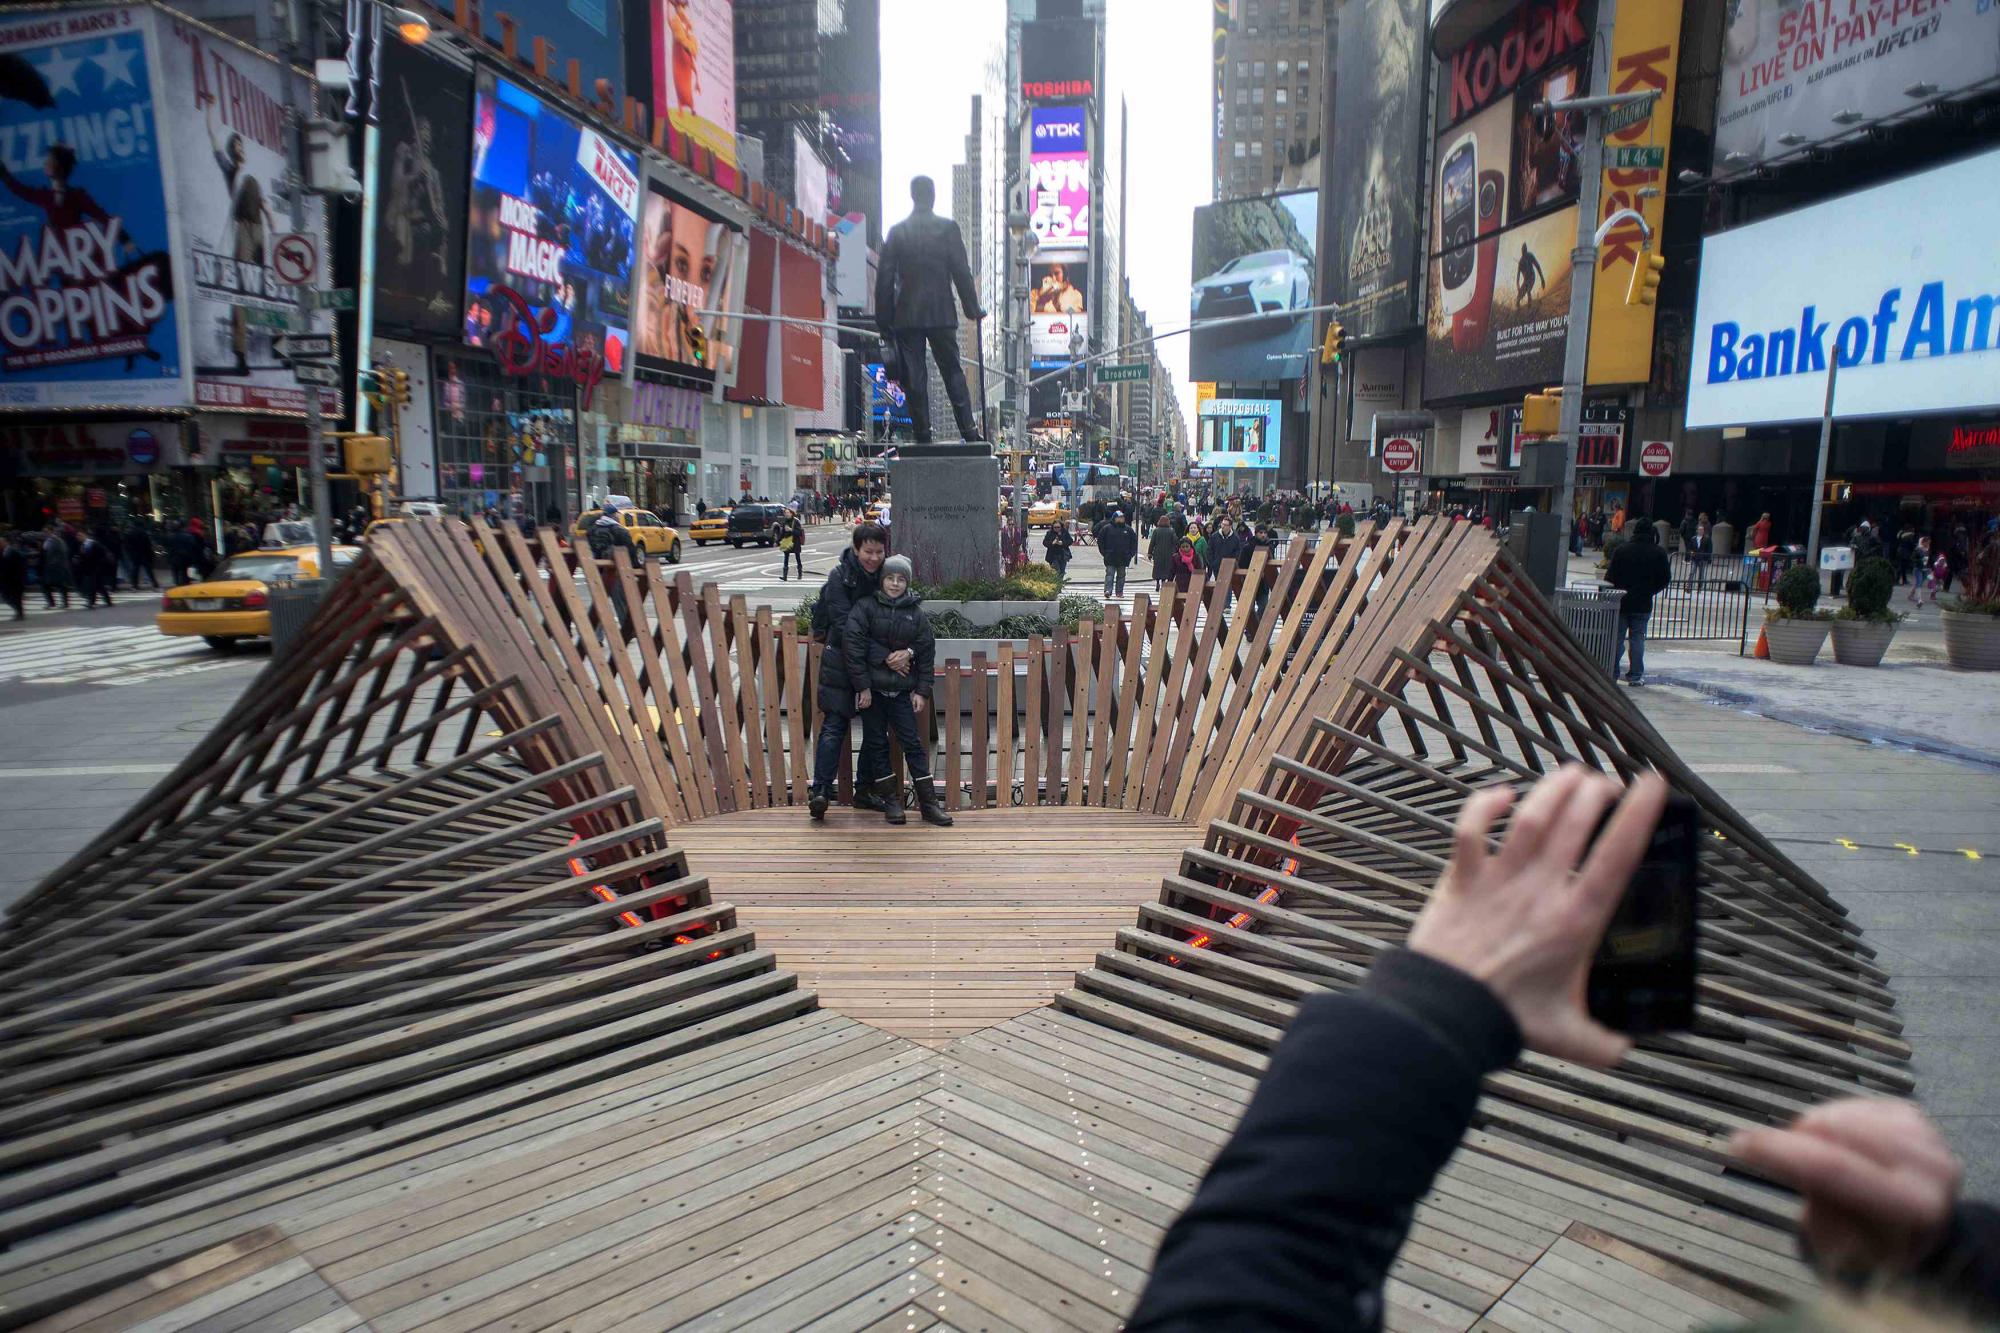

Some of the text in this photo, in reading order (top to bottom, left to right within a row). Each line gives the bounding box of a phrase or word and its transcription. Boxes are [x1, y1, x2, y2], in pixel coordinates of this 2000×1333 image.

[68, 11, 117, 33] MARCH
[120, 8, 132, 25] 3
[1740, 50, 1787, 97] LIVE
[1792, 32, 1826, 71] ON
[1806, 70, 1824, 85] ALSO
[1824, 52, 1862, 78] AVAILABLE
[1863, 49, 1874, 62] ON
[1023, 80, 1093, 97] TOSHIBA
[1608, 100, 1651, 132] BROADWAY
[1719, 89, 1782, 127] facebook.com/UFC
[1048, 122, 1080, 137] TDK
[1621, 149, 1630, 166] W
[1634, 148, 1648, 166] 46
[501, 193, 538, 235] MORE
[0, 217, 121, 292] MARY
[508, 230, 566, 286] MAGIC
[1, 264, 164, 348] OPPINS
[664, 272, 704, 308] FOREVER
[1496, 328, 1511, 341] BUILT
[1512, 325, 1523, 337] FOR
[1523, 321, 1534, 334] THE
[1535, 319, 1550, 331] WAY
[1550, 316, 1563, 329] YOU
[1707, 304, 1830, 385] Bank
[1836, 287, 1902, 369] of
[1104, 367, 1142, 380] Broadway
[1360, 383, 1395, 393] Marriott
[1211, 401, 1271, 415] AÉROPOSTALE
